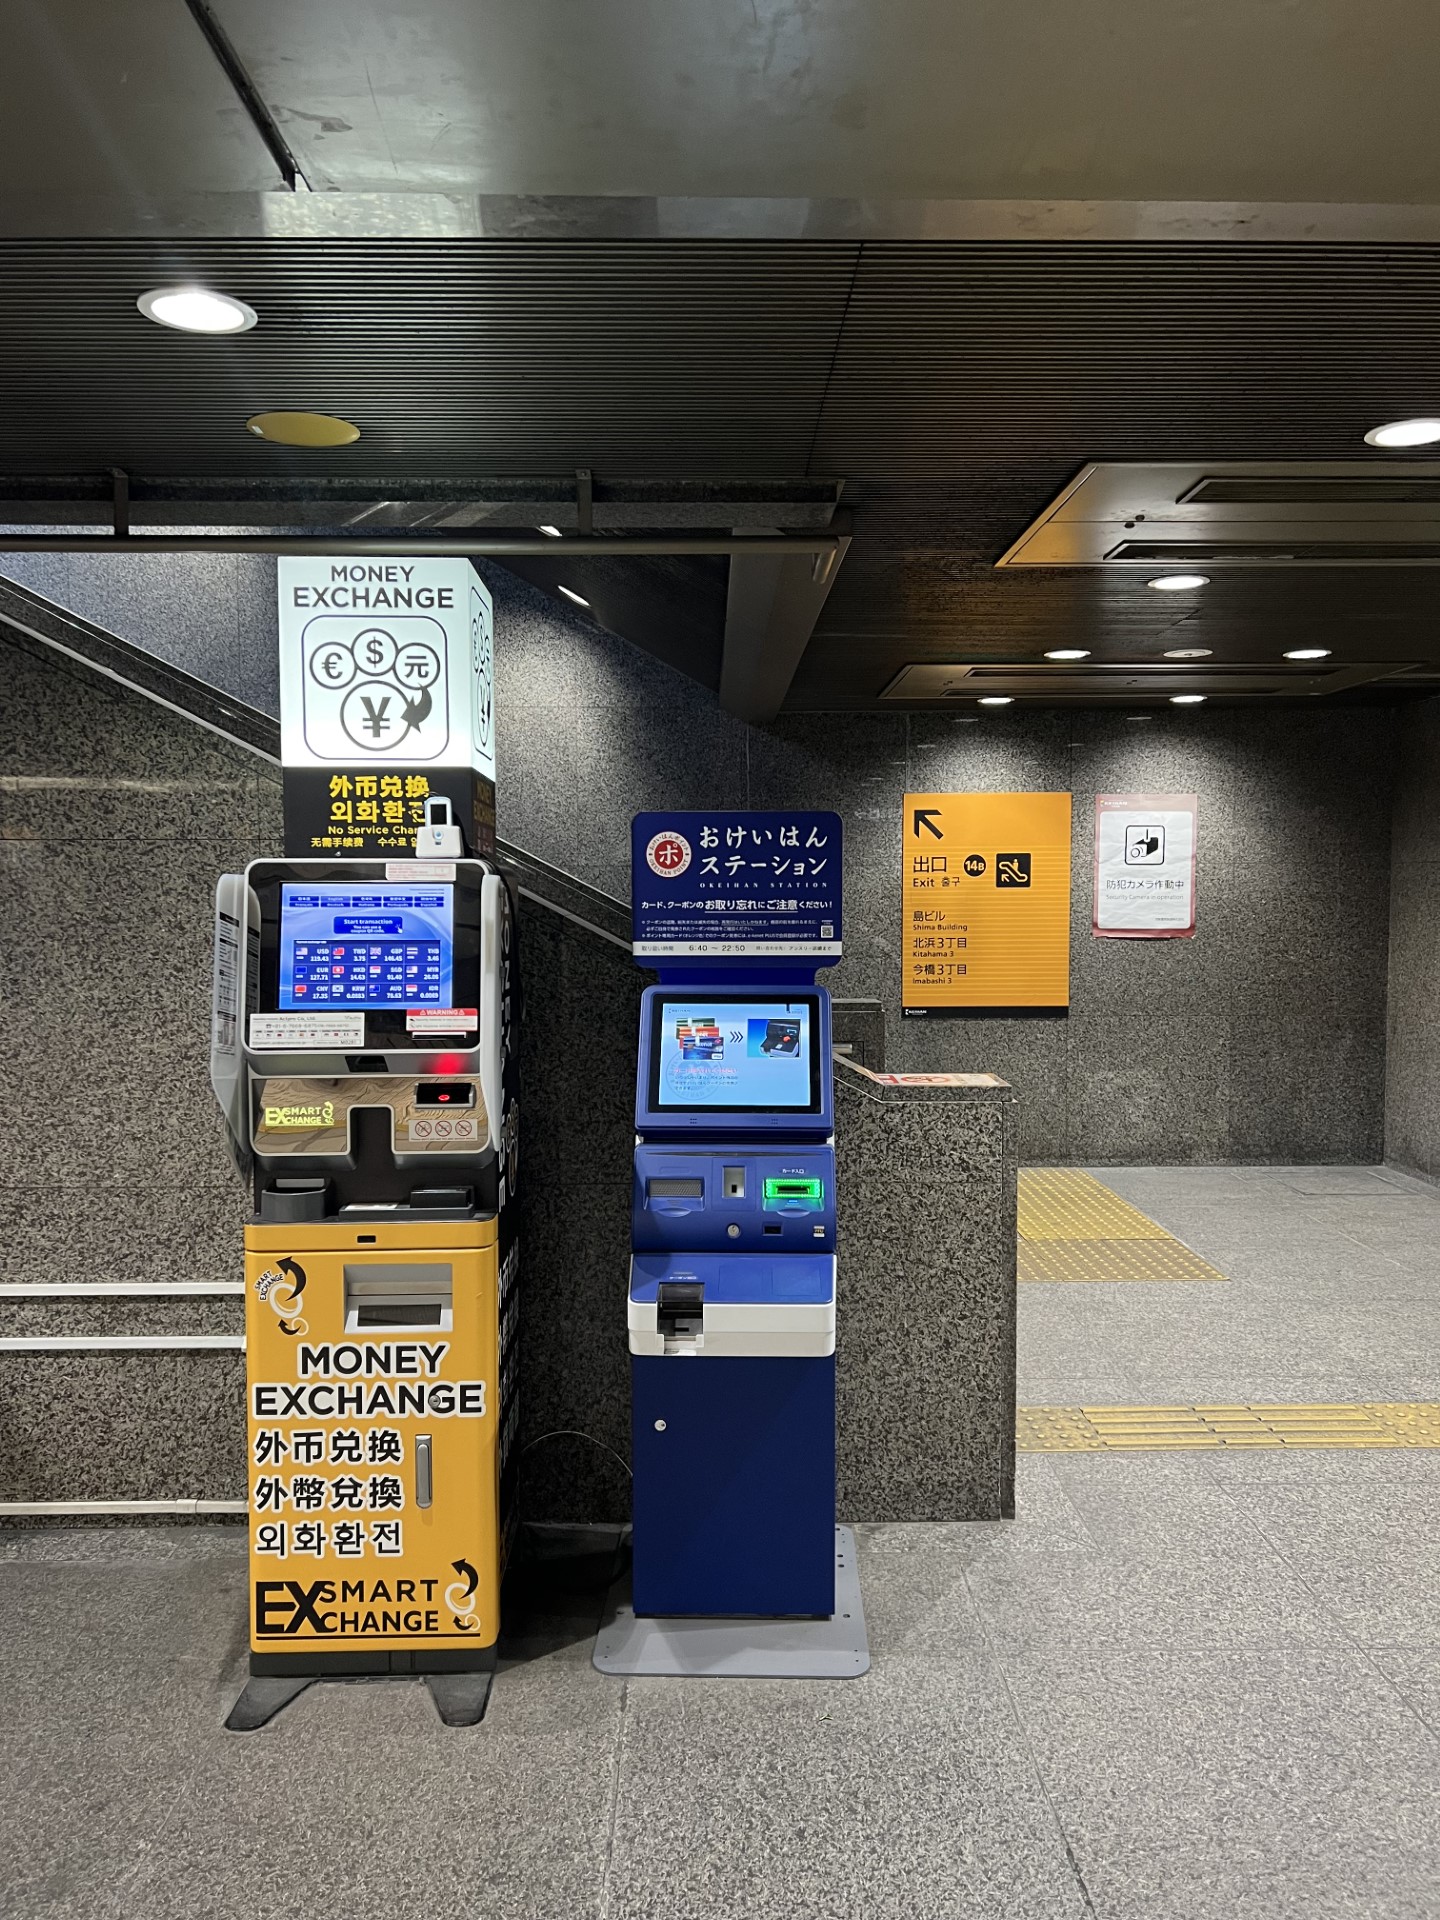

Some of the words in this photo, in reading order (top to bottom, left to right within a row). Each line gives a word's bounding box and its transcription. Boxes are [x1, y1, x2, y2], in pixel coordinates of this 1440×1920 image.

[331, 566, 414, 582] MONEY
[293, 586, 454, 609] EXCHANGE
[366, 637, 383, 668] $
[322, 652, 343, 679] €
[404, 655, 429, 679] 元
[360, 696, 391, 738] ¥
[329, 775, 430, 798] 外币兑换
[328, 826, 343, 834] No
[347, 825, 389, 835] Service
[393, 825, 418, 835] Char
[700, 825, 828, 848] おけいはん
[311, 838, 364, 848] 无需手续费
[377, 838, 407, 848] 수수료
[658, 843, 679, 866] ポ
[700, 855, 828, 876] ステーション
[913, 856, 947, 873] 出口
[965, 860, 985, 871] 14B
[913, 877, 935, 888] Exit
[1106, 880, 1185, 890] 防犯カメラ作動中
[913, 910, 946, 922] 島ビル
[937, 924, 968, 932] Building
[913, 937, 967, 949] 北浜3丁目
[913, 964, 967, 976] 今橋3丁目
[286, 1107, 322, 1115] SMART
[286, 1116, 322, 1125] CHANGE
[254, 1270, 272, 1291] SMART
[259, 1273, 284, 1301] EXCHANGE
[301, 1345, 446, 1375] MONEY
[255, 1384, 482, 1416] EXCHANGE
[255, 1430, 401, 1464] 外币兑换
[255, 1476, 402, 1510] 外幣兌換
[256, 1521, 401, 1557] 외화환전
[255, 1580, 328, 1634] EX
[318, 1579, 439, 1603] SMART
[321, 1610, 439, 1633] CHANGE
